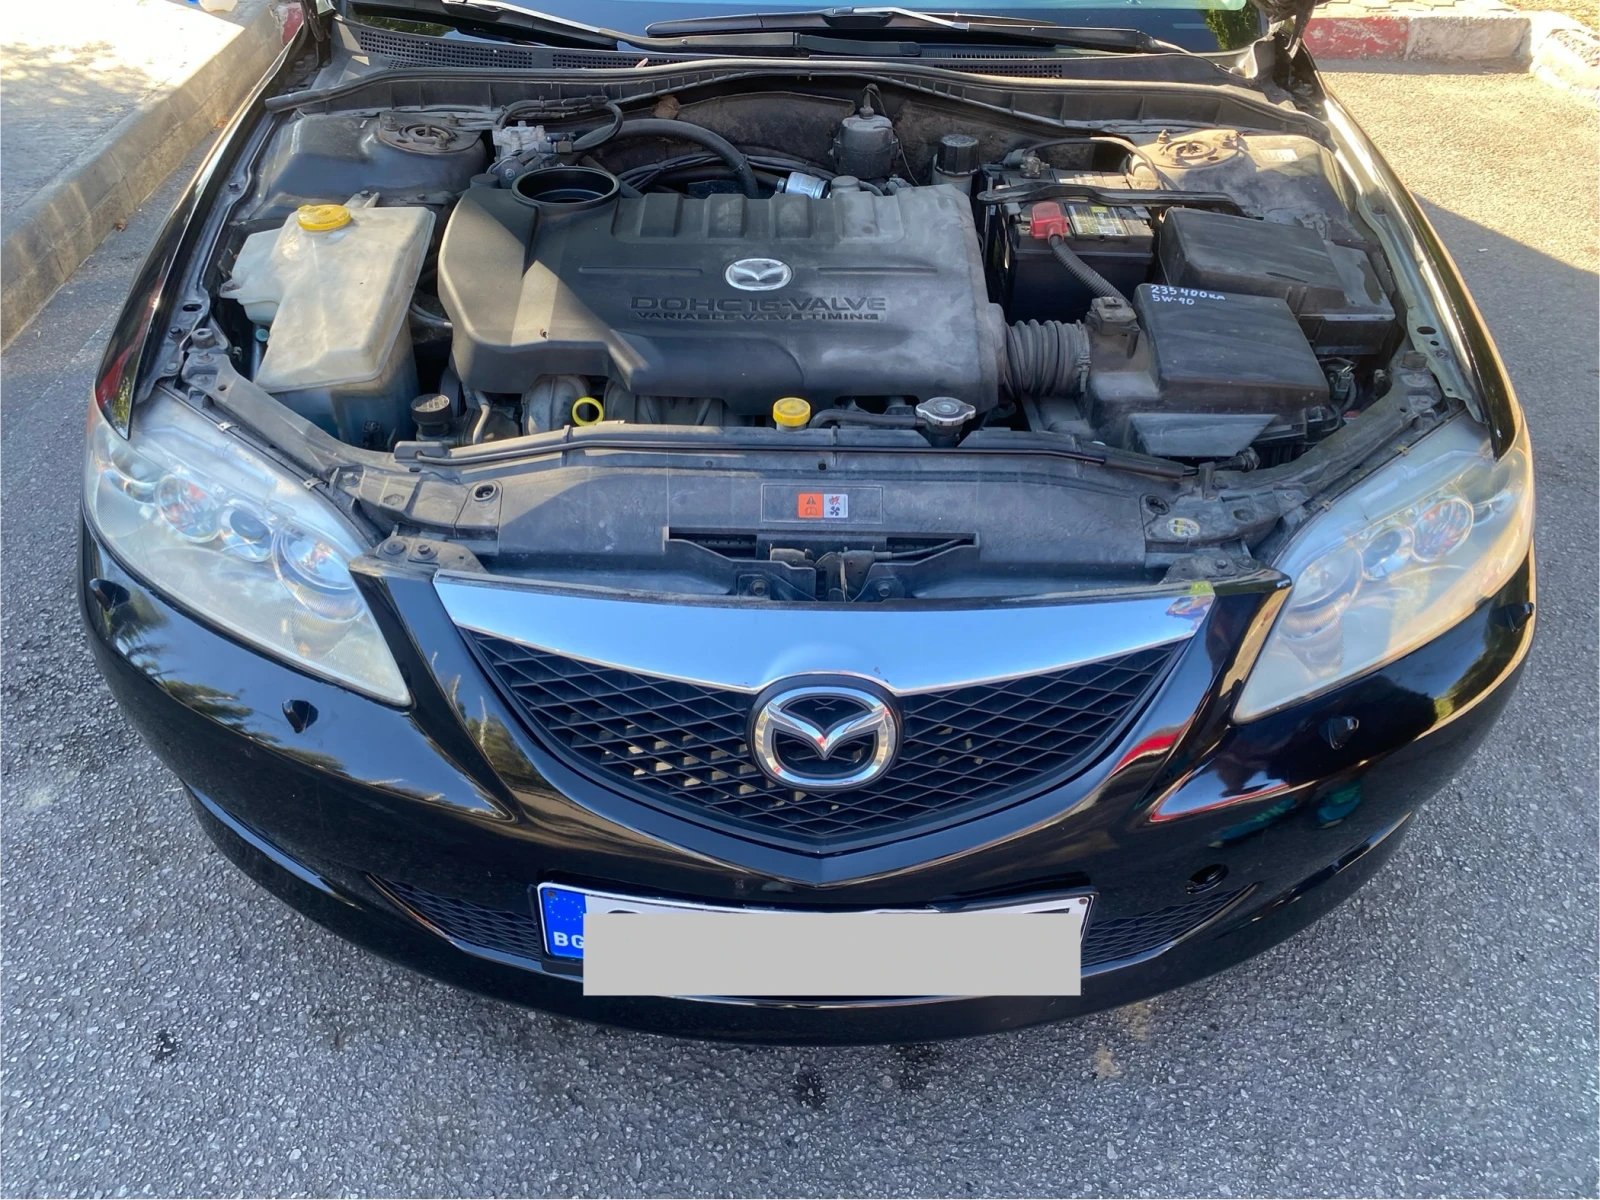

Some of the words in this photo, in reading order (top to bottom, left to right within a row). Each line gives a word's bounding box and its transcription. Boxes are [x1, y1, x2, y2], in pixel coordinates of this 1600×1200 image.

[1150, 284, 1178, 295] 235
[630, 296, 742, 312] DOHC
[748, 297, 886, 312] 16-VALVE
[811, 312, 879, 321] TIMING
[553, 931, 584, 949] BG
